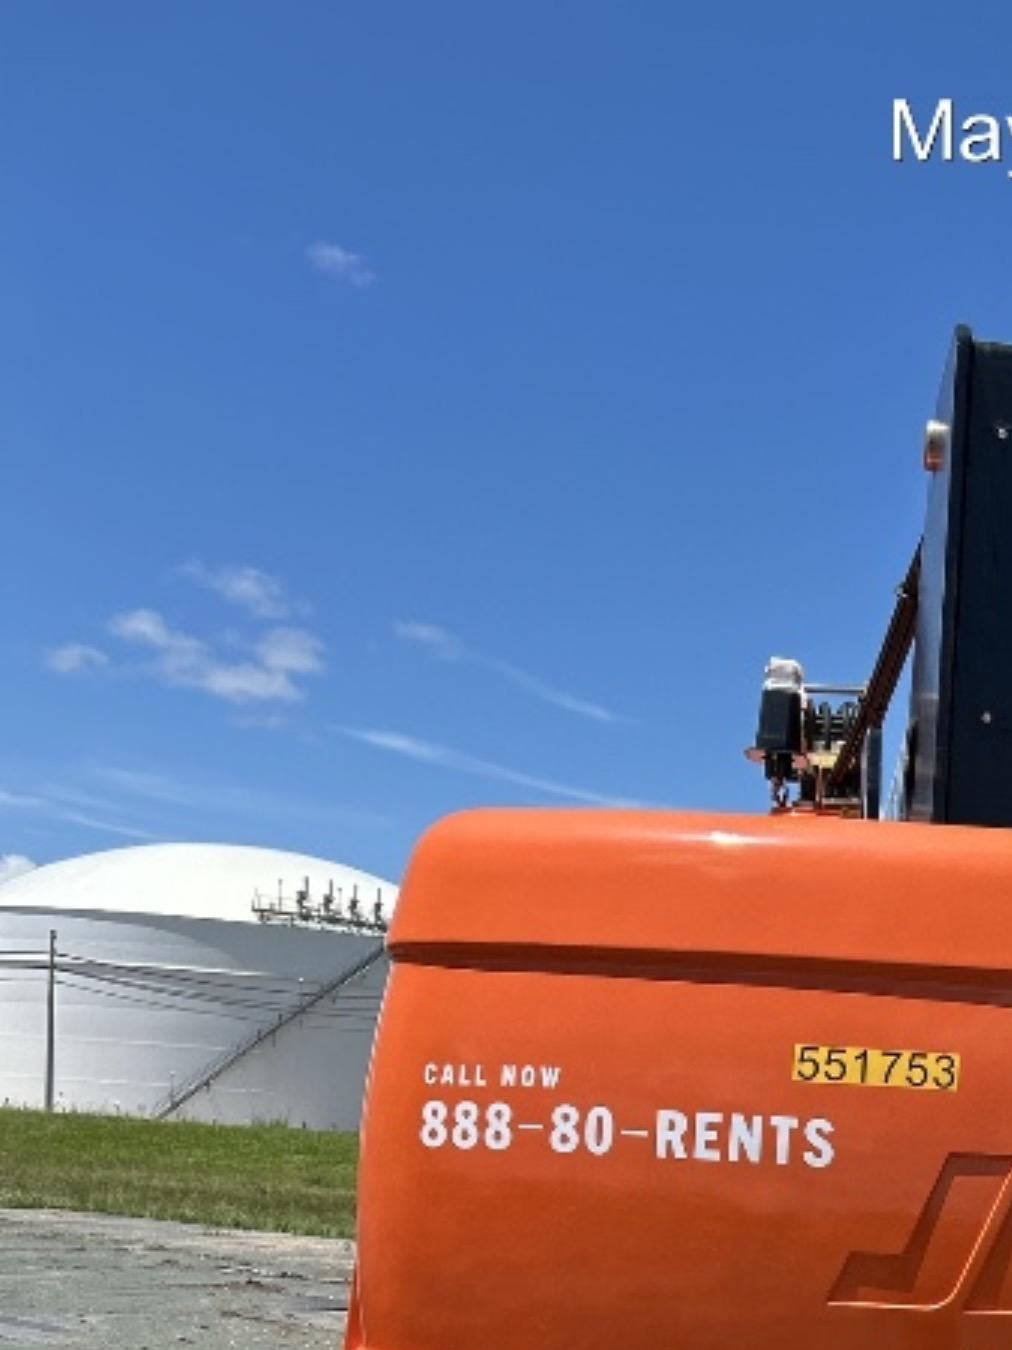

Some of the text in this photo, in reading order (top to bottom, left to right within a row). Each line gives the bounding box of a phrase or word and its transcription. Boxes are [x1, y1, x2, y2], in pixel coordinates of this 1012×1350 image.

[424, 1063, 562, 1089] CALL NOW
[796, 1045, 956, 1090] 551753
[419, 1100, 836, 1168] 888-80-RENTS
